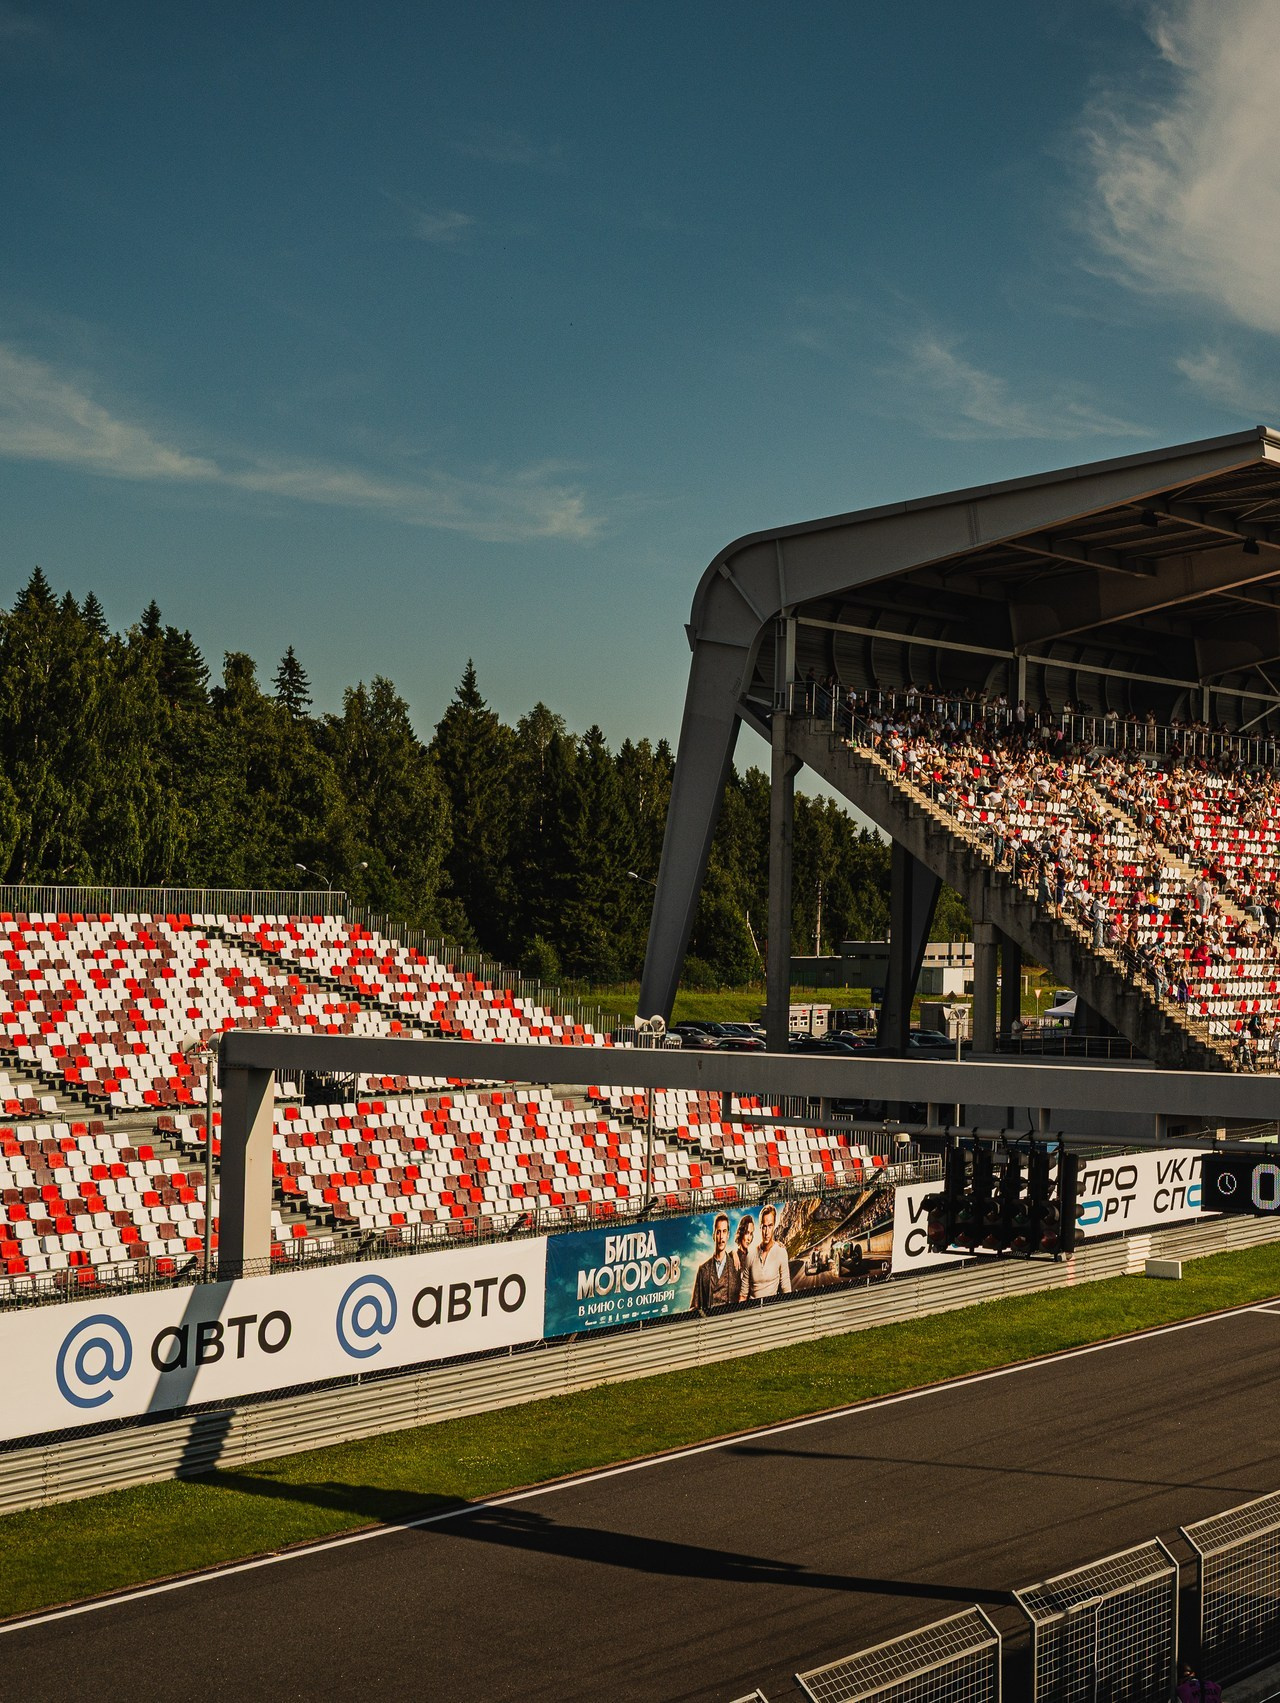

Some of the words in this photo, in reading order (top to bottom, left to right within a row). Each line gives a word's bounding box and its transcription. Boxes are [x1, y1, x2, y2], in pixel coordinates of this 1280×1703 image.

[1080, 1164, 1138, 1197] ПРО
[1156, 1157, 1188, 1185] VK
[605, 1230, 658, 1265] БИТВА
[577, 1255, 681, 1300] МОТОРОВ
[578, 1305, 586, 1317] В
[587, 1300, 615, 1315] КИНО
[617, 1298, 625, 1310] С
[627, 1296, 633, 1308] 8
[635, 1289, 675, 1306] ОКТЯБРЯ
